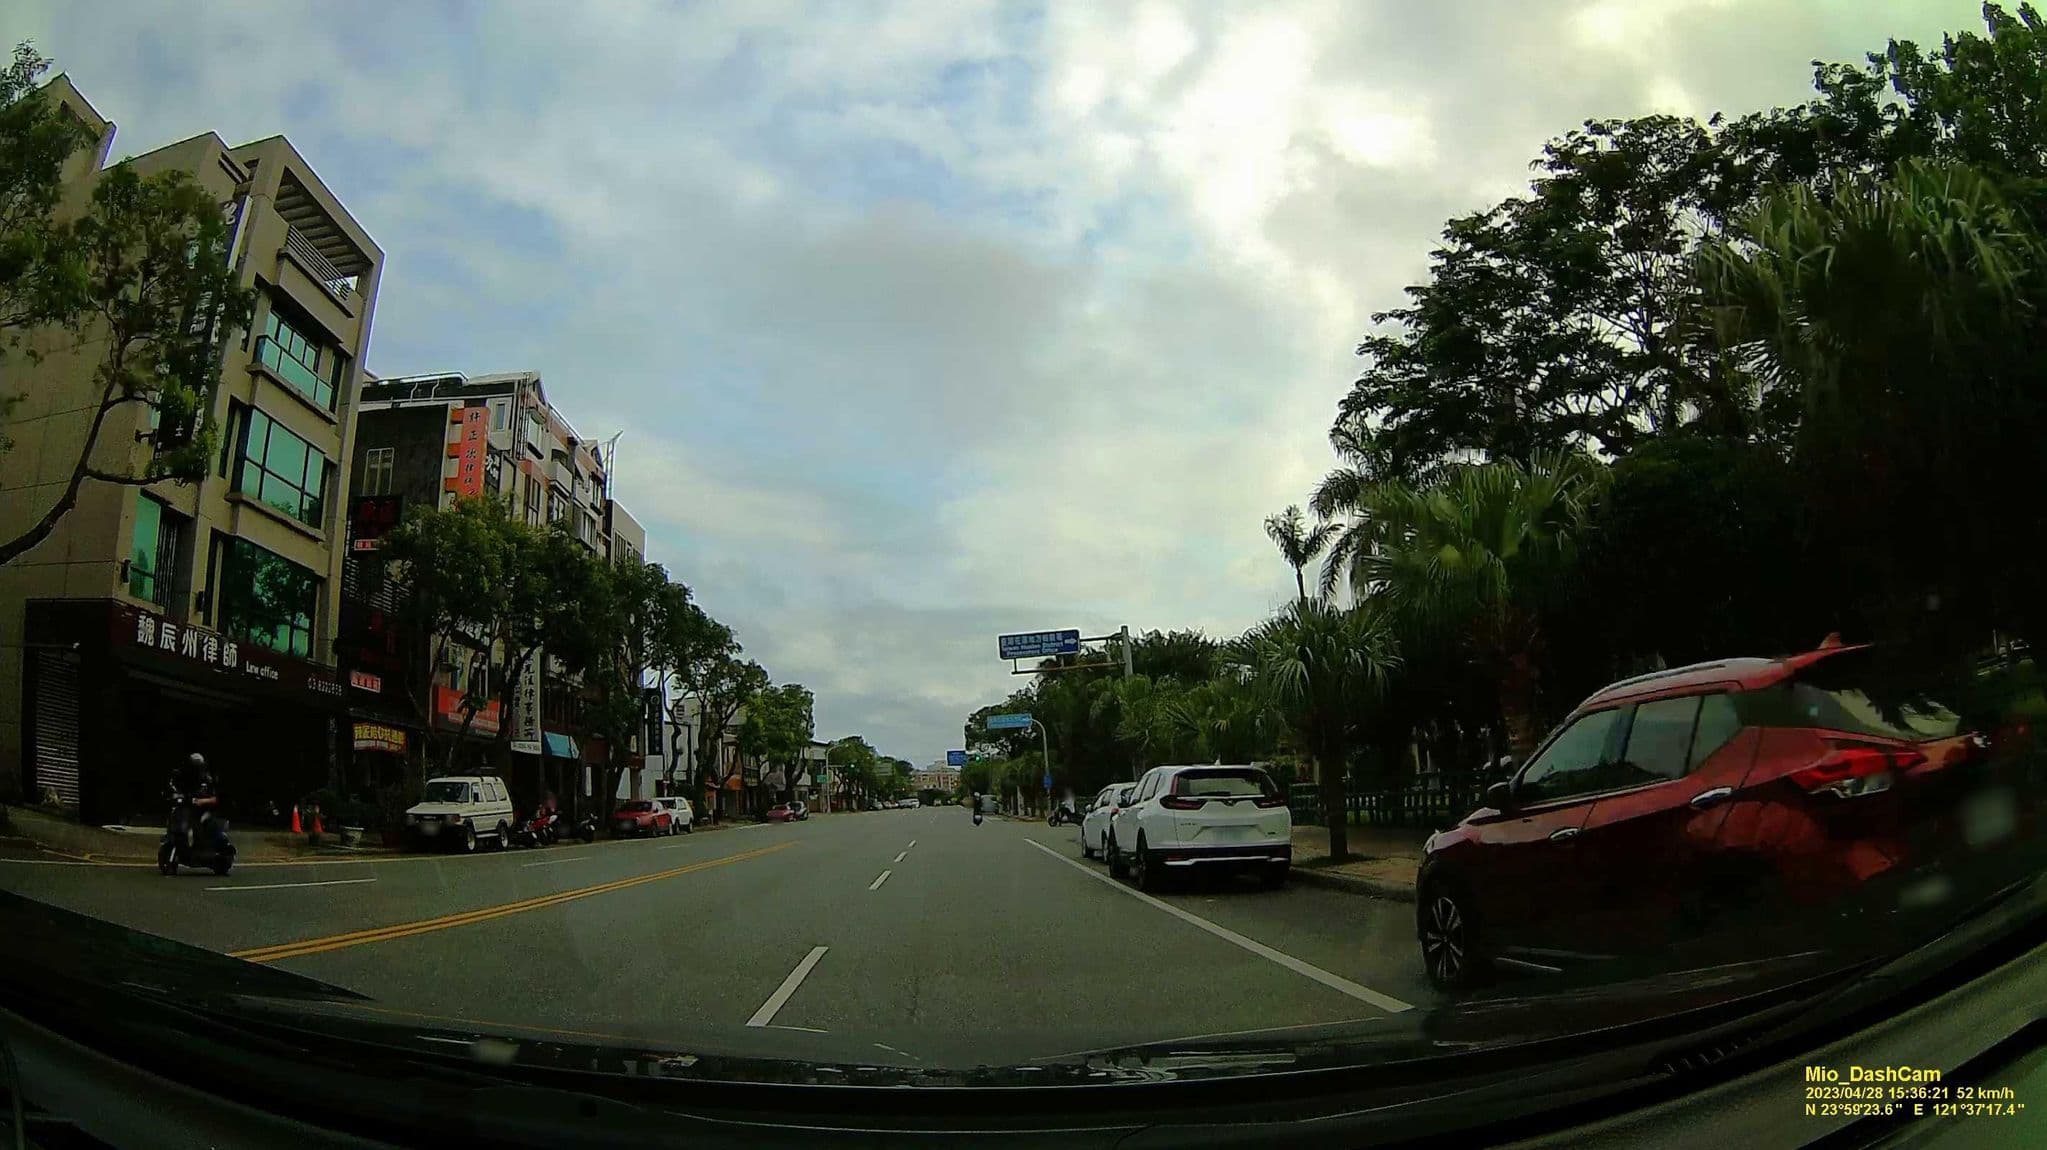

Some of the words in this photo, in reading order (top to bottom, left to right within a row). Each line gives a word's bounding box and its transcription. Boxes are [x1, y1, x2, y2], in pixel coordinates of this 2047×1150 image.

[136, 614, 238, 668] 魏辰州律師
[245, 660, 260, 674] Law
[260, 663, 280, 680] office
